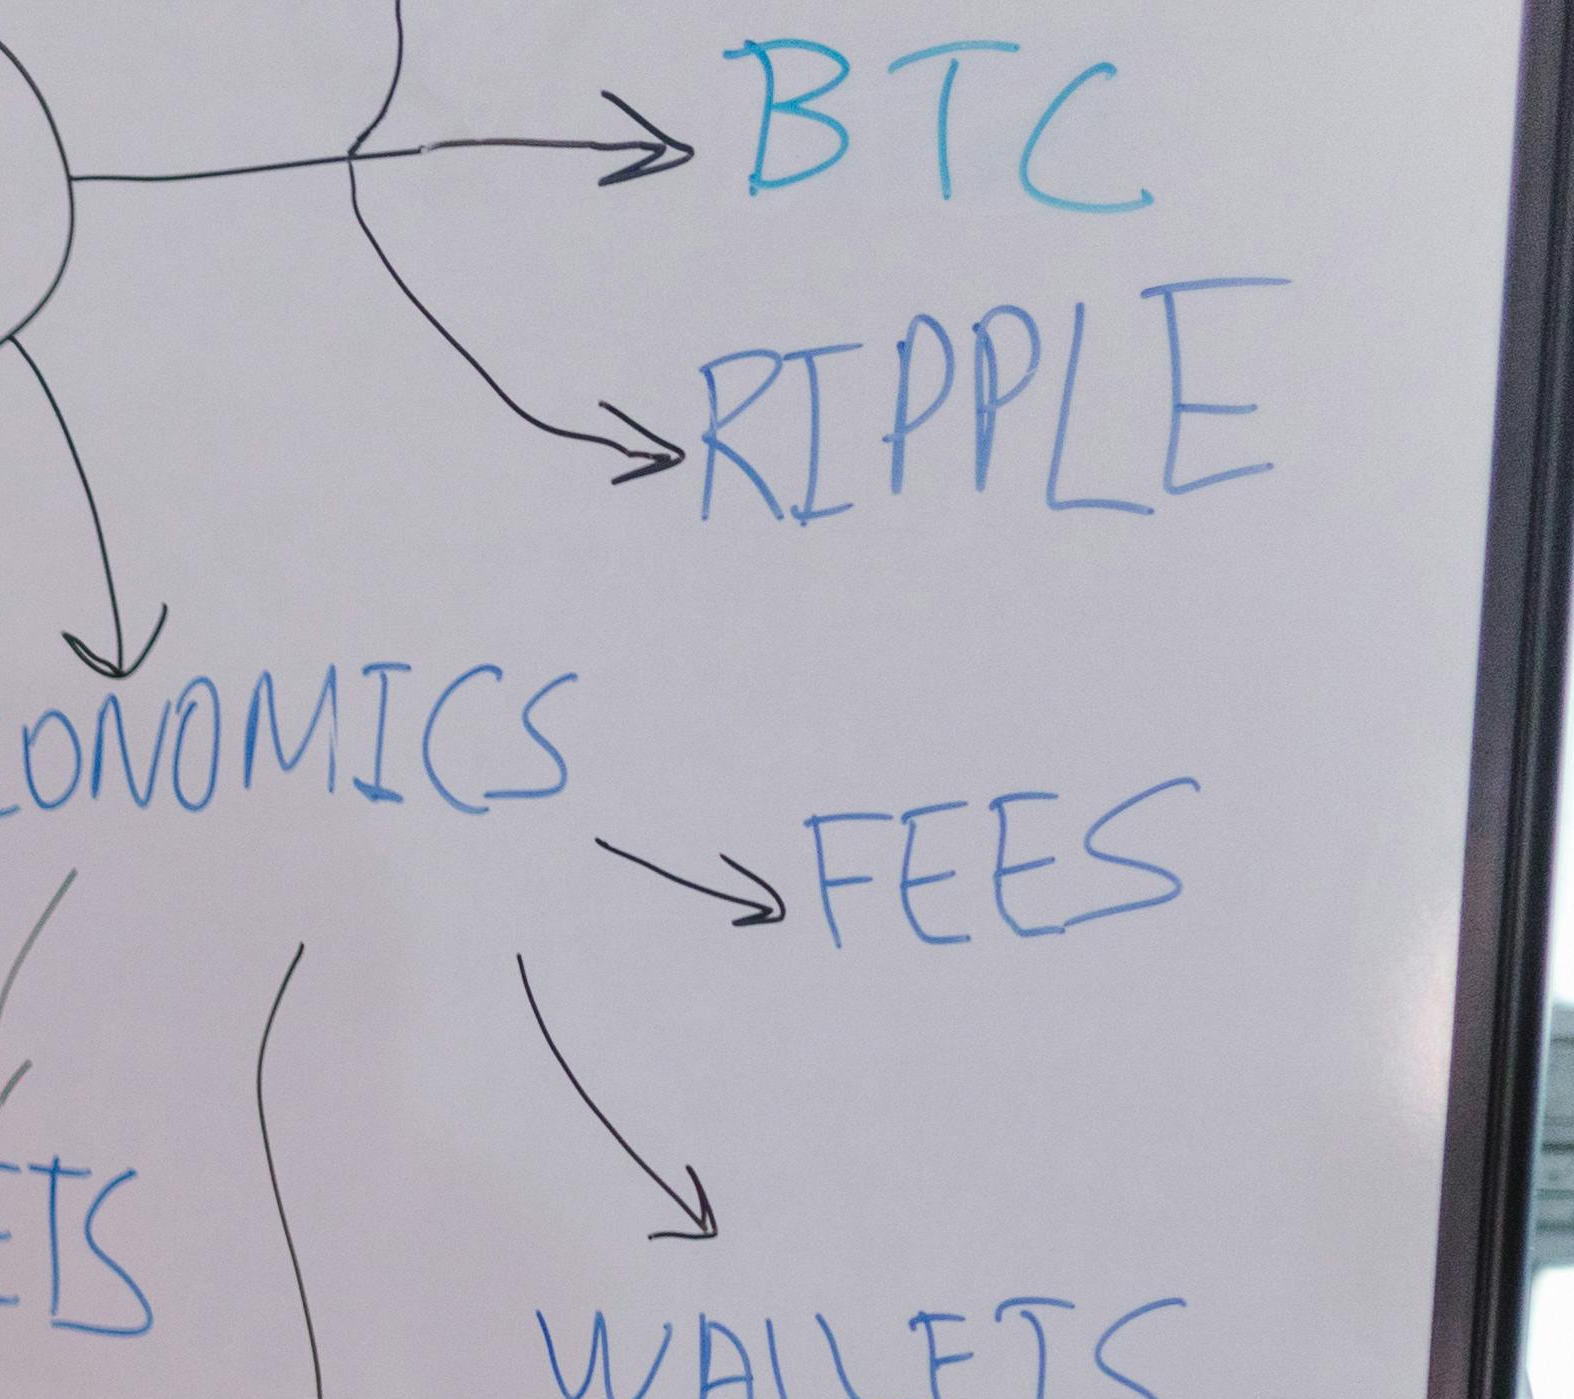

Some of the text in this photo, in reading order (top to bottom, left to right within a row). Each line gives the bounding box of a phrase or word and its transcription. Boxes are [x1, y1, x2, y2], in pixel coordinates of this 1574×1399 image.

[721, 36, 1155, 214] BTC
[697, 275, 1290, 527] RIPPLE
[803, 776, 1200, 947] FEES
